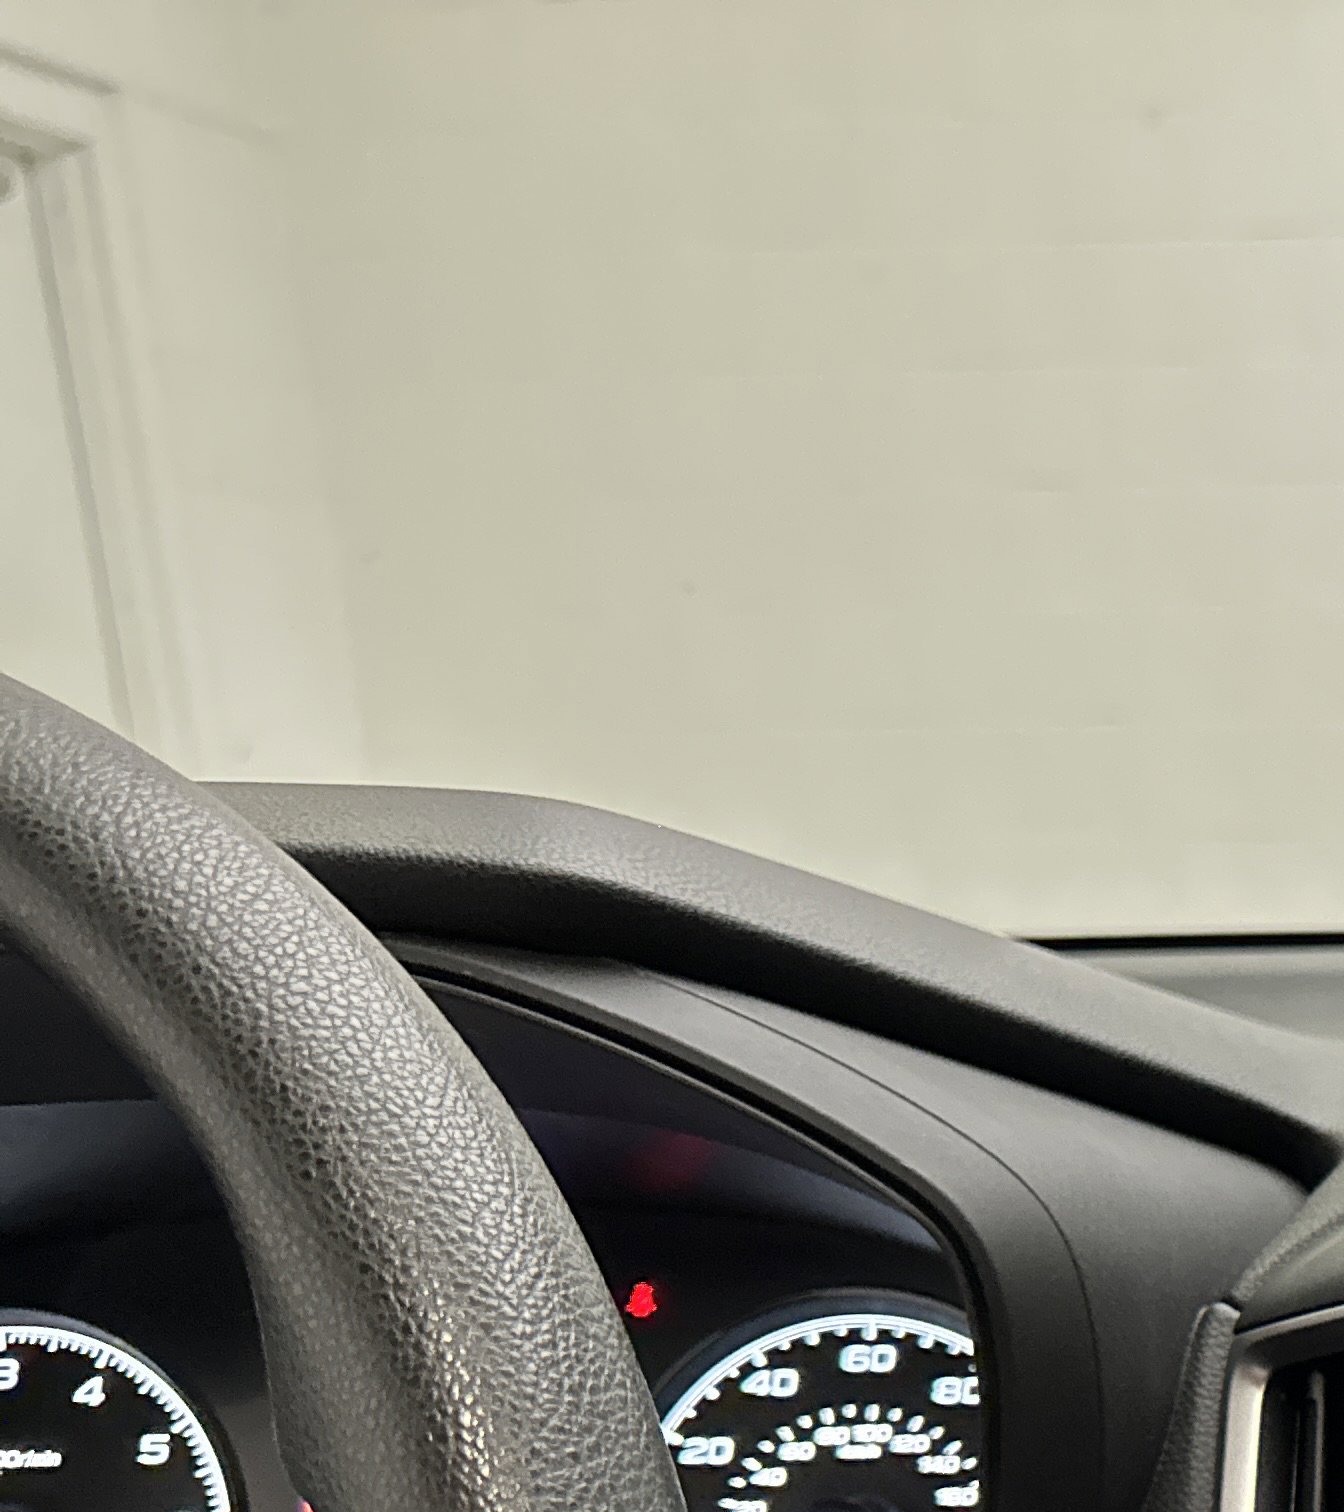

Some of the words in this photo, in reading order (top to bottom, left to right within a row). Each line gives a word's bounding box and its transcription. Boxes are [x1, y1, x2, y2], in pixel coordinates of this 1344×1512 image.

[838, 1343, 898, 1374] 60
[71, 1374, 107, 1408] 4
[739, 1367, 800, 1398] 40
[135, 1432, 172, 1467] 5
[677, 1436, 735, 1466] 20
